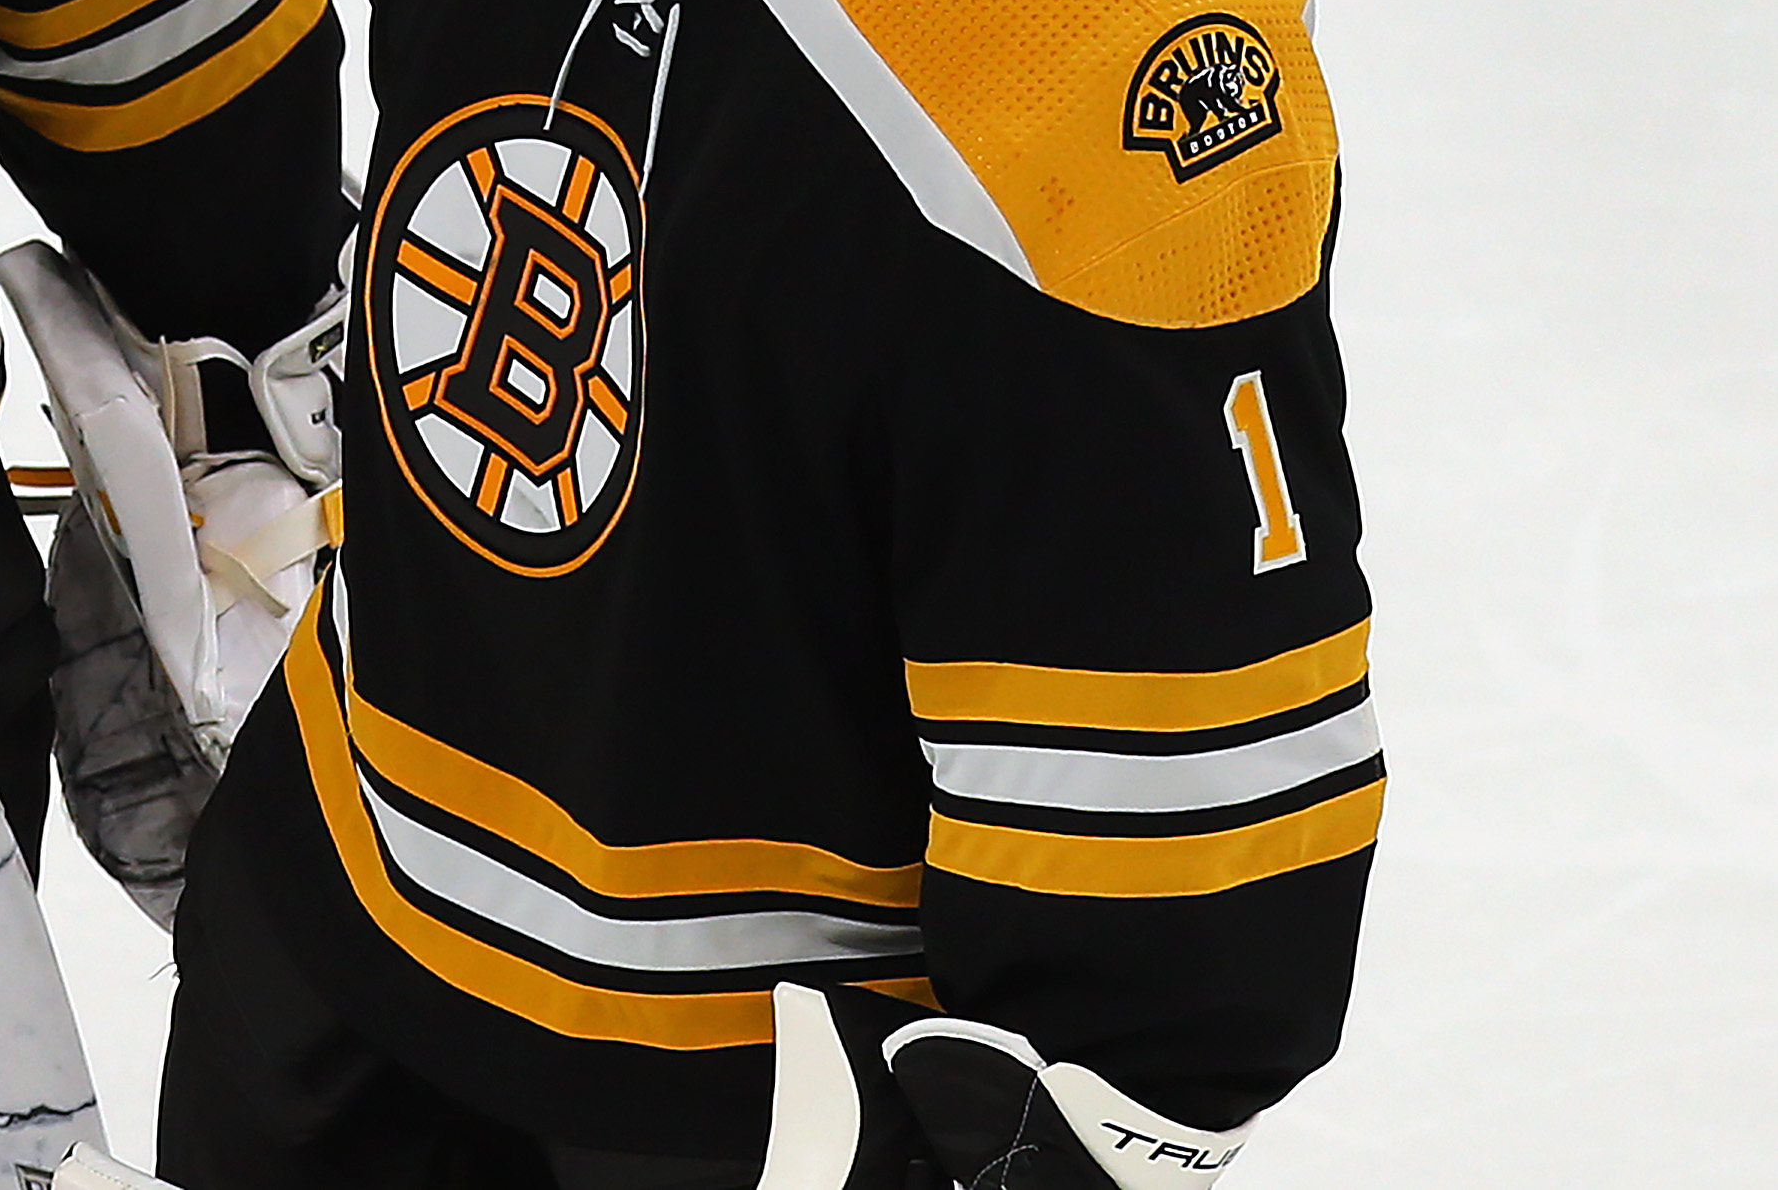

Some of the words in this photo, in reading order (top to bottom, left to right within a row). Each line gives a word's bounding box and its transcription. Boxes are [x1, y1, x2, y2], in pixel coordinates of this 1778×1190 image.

[1139, 32, 1270, 131] BRUINS
[434, 183, 609, 477] B
[1225, 370, 1307, 576] 1
